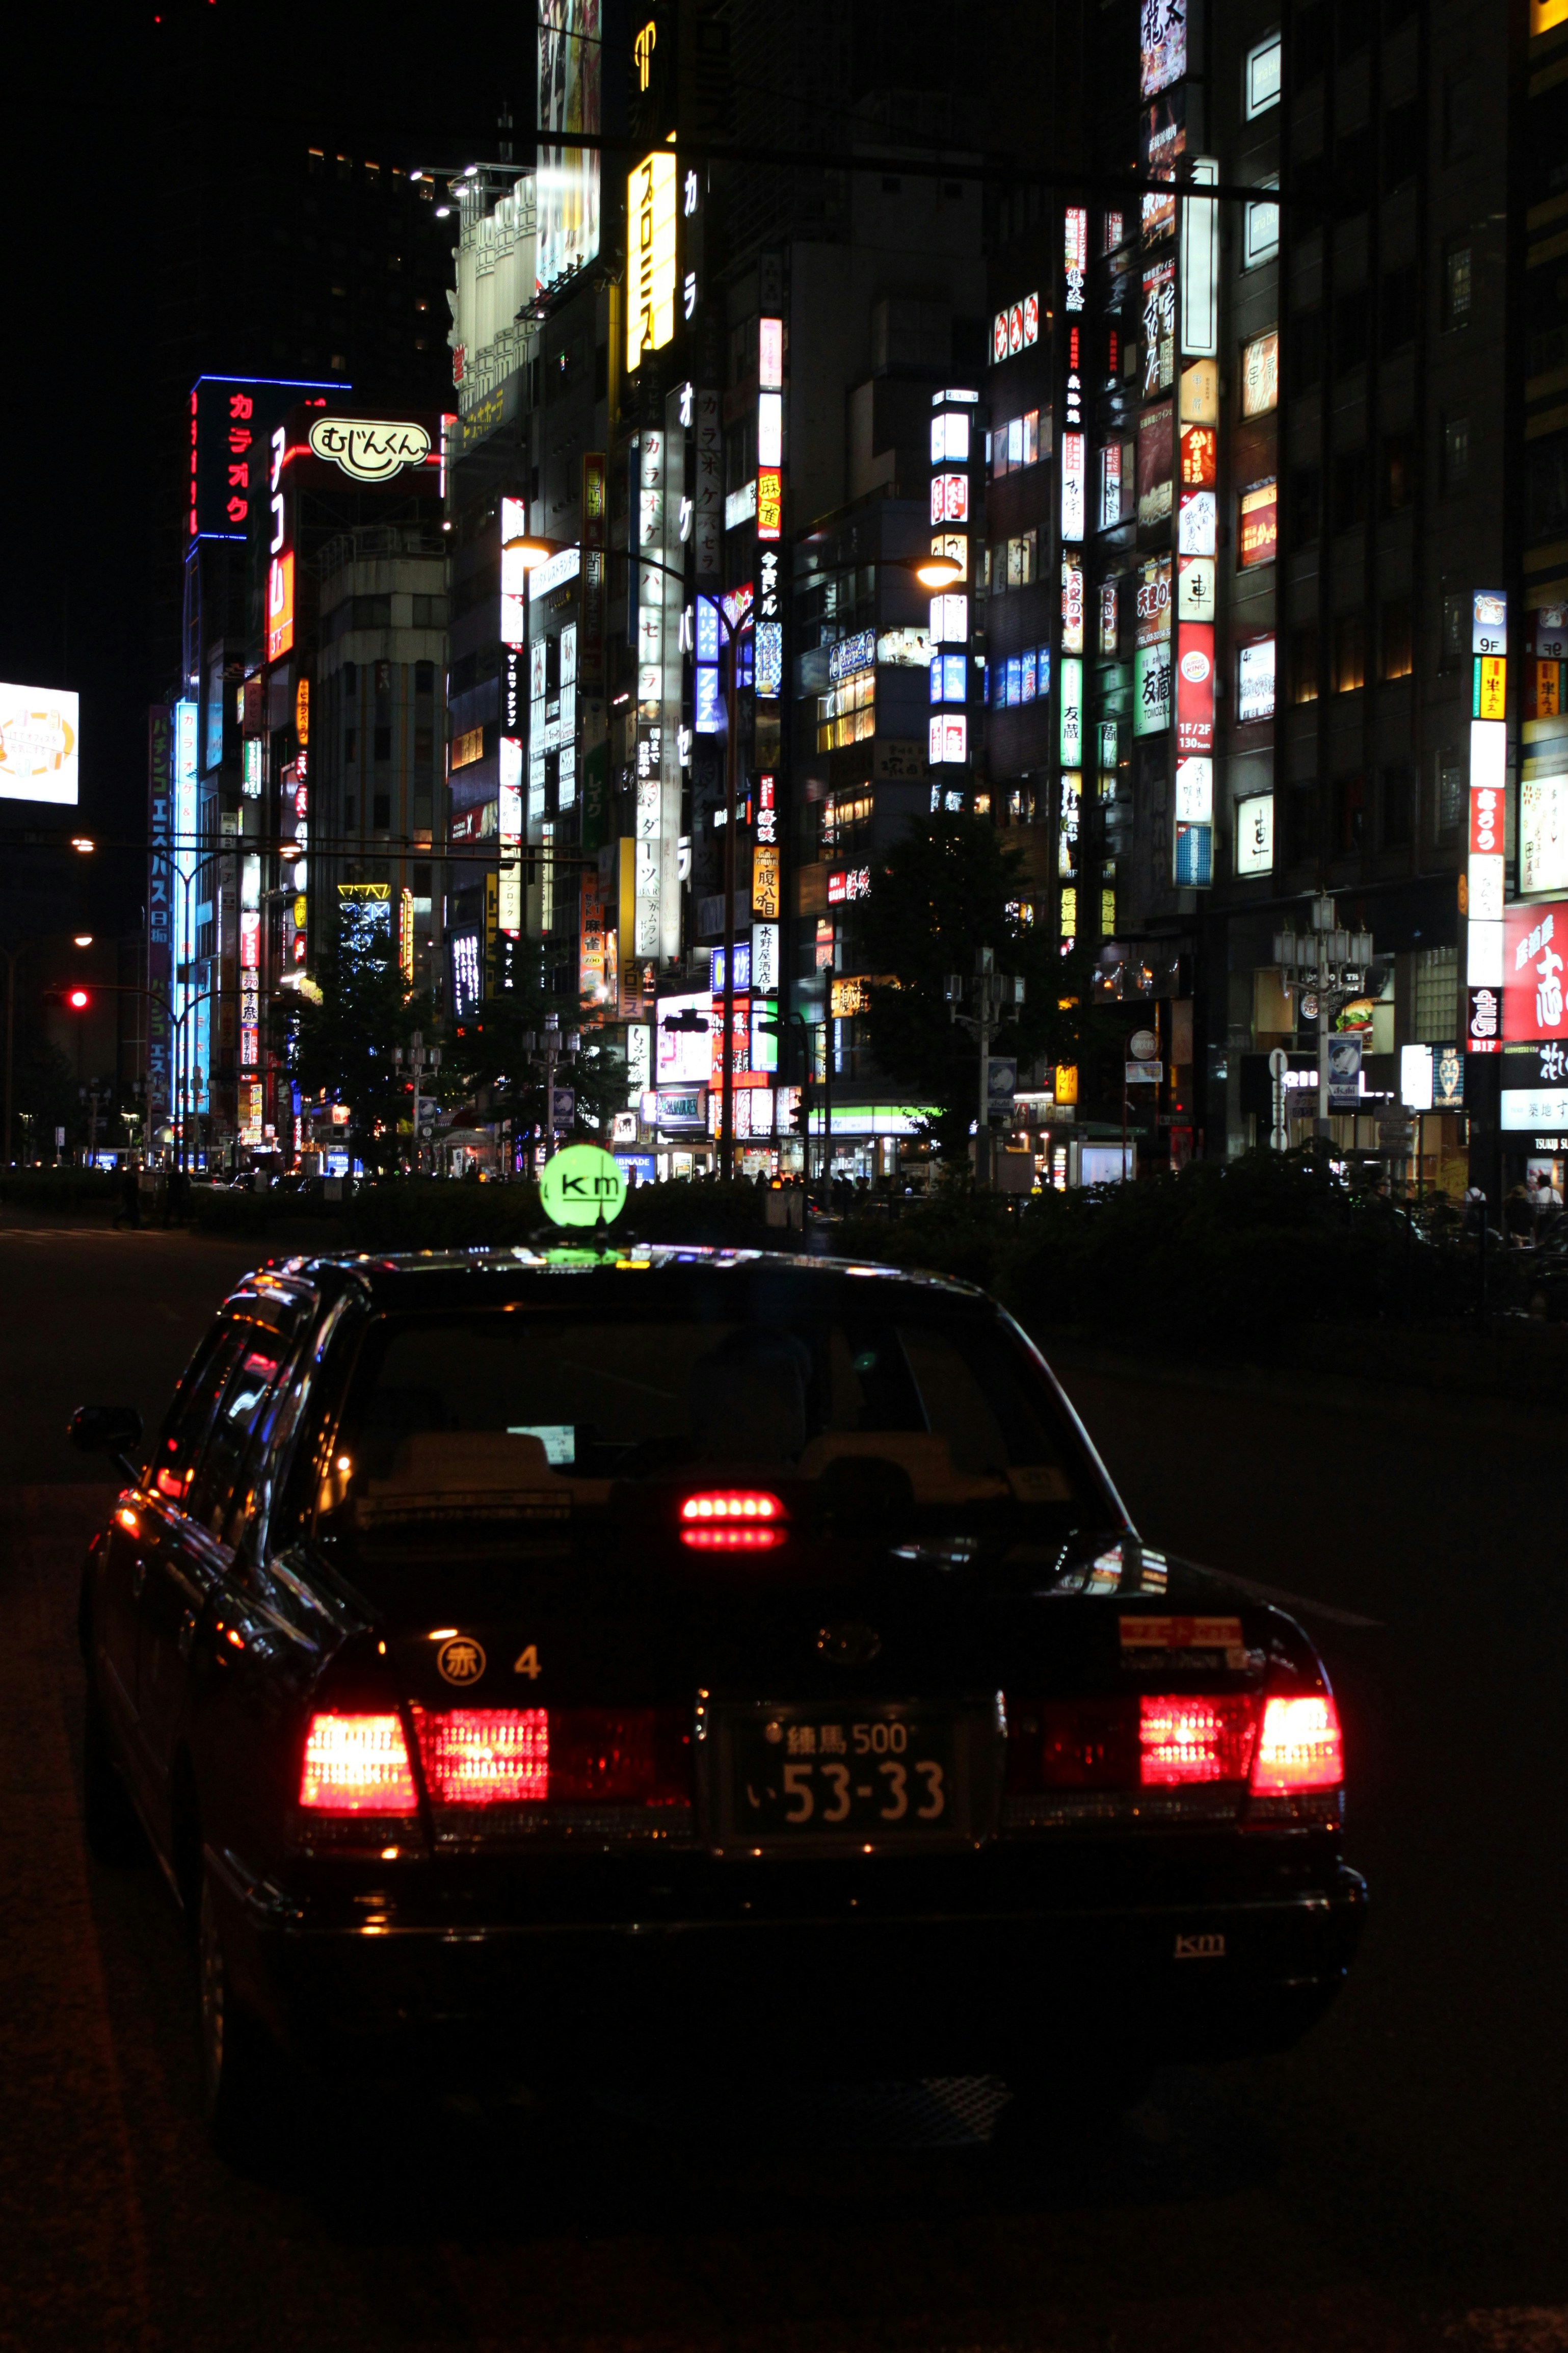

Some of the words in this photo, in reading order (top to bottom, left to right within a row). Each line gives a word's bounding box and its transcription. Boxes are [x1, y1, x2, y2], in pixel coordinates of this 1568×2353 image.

[1067, 210, 1078, 218] 9F
[227, 393, 253, 522] カラオケ
[322, 427, 424, 471] むじんくん
[759, 475, 781, 527] 麻雀
[1181, 495, 1191, 503] 4F
[269, 426, 286, 616] アコム
[642, 438, 660, 689] カラオケパセラ
[1187, 573, 1212, 609] 車
[1186, 659, 1205, 667] BURGER
[1242, 650, 1252, 663] 4F
[1480, 638, 1500, 652] 9F
[1186, 663, 1206, 674] KING
[699, 669, 715, 720] 747
[1064, 705, 1079, 739] 友蔵
[639, 741, 651, 778] 営業中
[649, 727, 661, 764] 朝まで
[1179, 737, 1197, 748] 130
[642, 818, 660, 884] ダーツ
[1253, 809, 1269, 866] 車
[639, 887, 658, 896] BAR
[584, 919, 601, 952] 麻雀
[757, 926, 773, 984] 水野屋酒店
[243, 979, 258, 987] 270
[624, 960, 639, 1015] プロミス
[1470, 989, 1497, 1038] HUB
[1472, 1040, 1496, 1052] B1F
[752, 1126, 771, 1135] 24H
[1535, 1138, 1559, 1151] TSUKIJI
[445, 1641, 479, 1679] 赤
[513, 1644, 542, 1681] 4
[786, 1724, 847, 1757] 練馬
[852, 1722, 908, 1755] 500
[746, 1784, 778, 1810] い
[783, 1760, 946, 1824] 53-33
